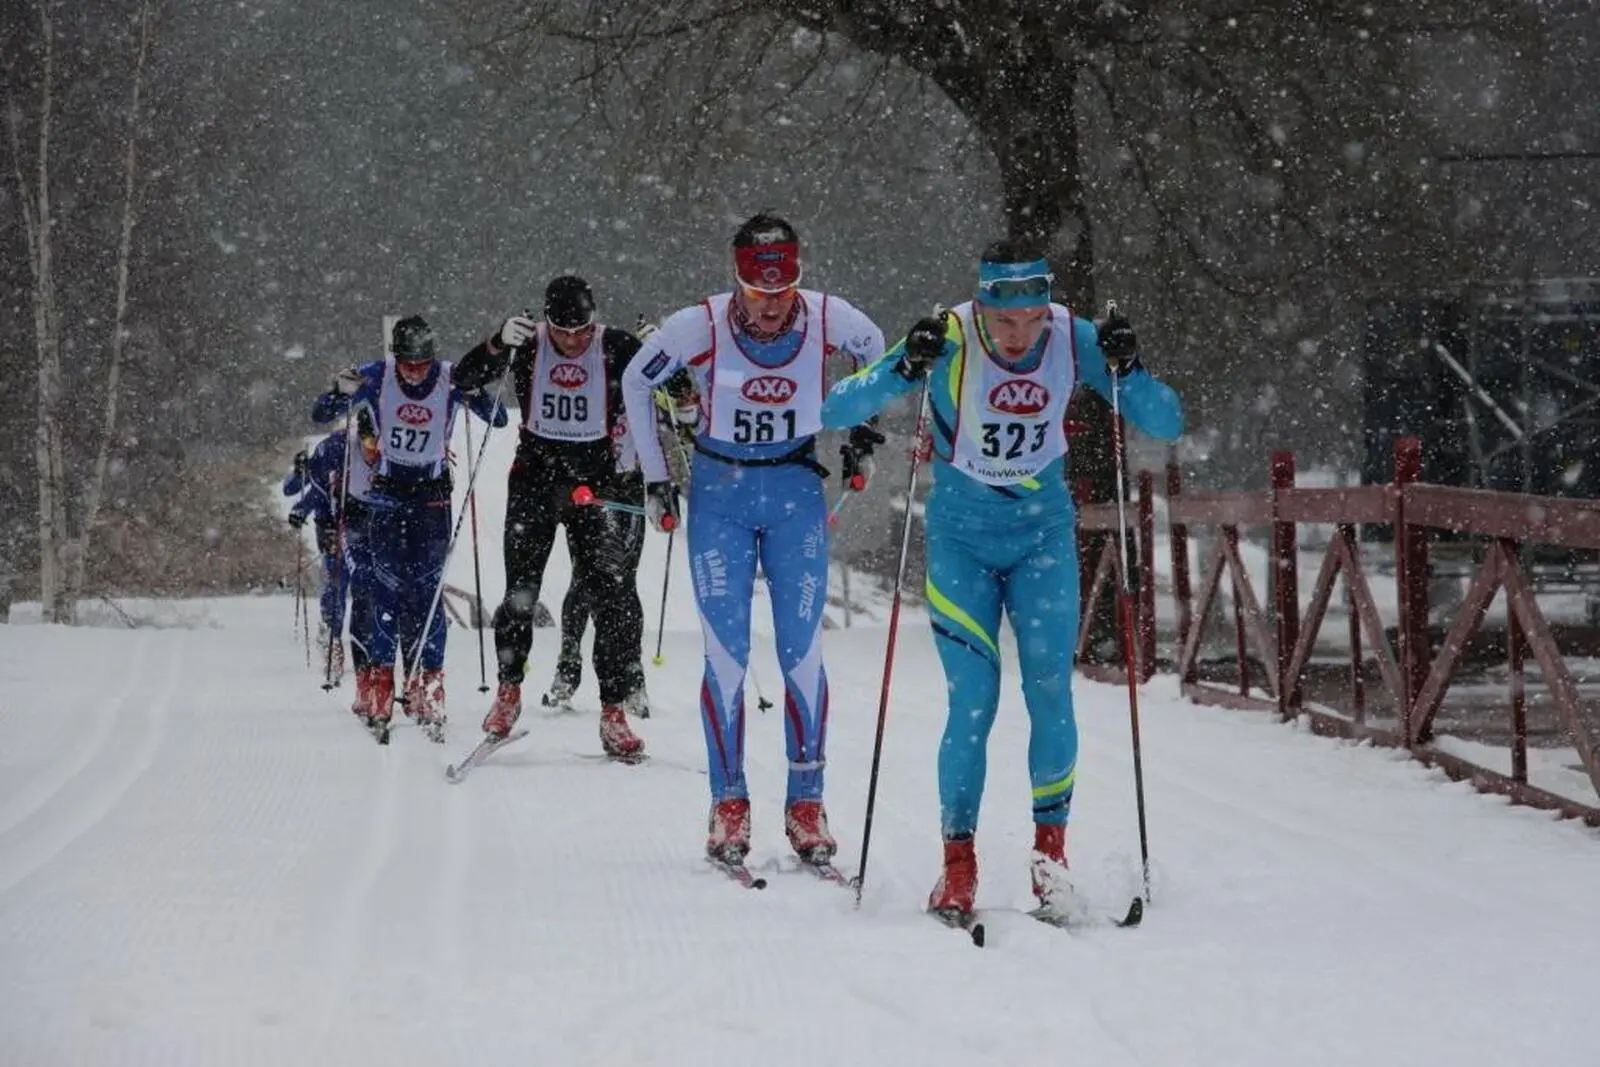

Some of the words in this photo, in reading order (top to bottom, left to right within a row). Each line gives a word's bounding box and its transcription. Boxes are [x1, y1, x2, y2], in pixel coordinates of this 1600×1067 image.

[551, 366, 587, 382] AXA
[747, 379, 792, 397] AXA
[995, 382, 1046, 407] AXA
[399, 405, 433, 422] AXA
[542, 392, 588, 422] 509
[734, 409, 796, 443] 561
[390, 426, 431, 453] 527
[981, 420, 1050, 460] 323
